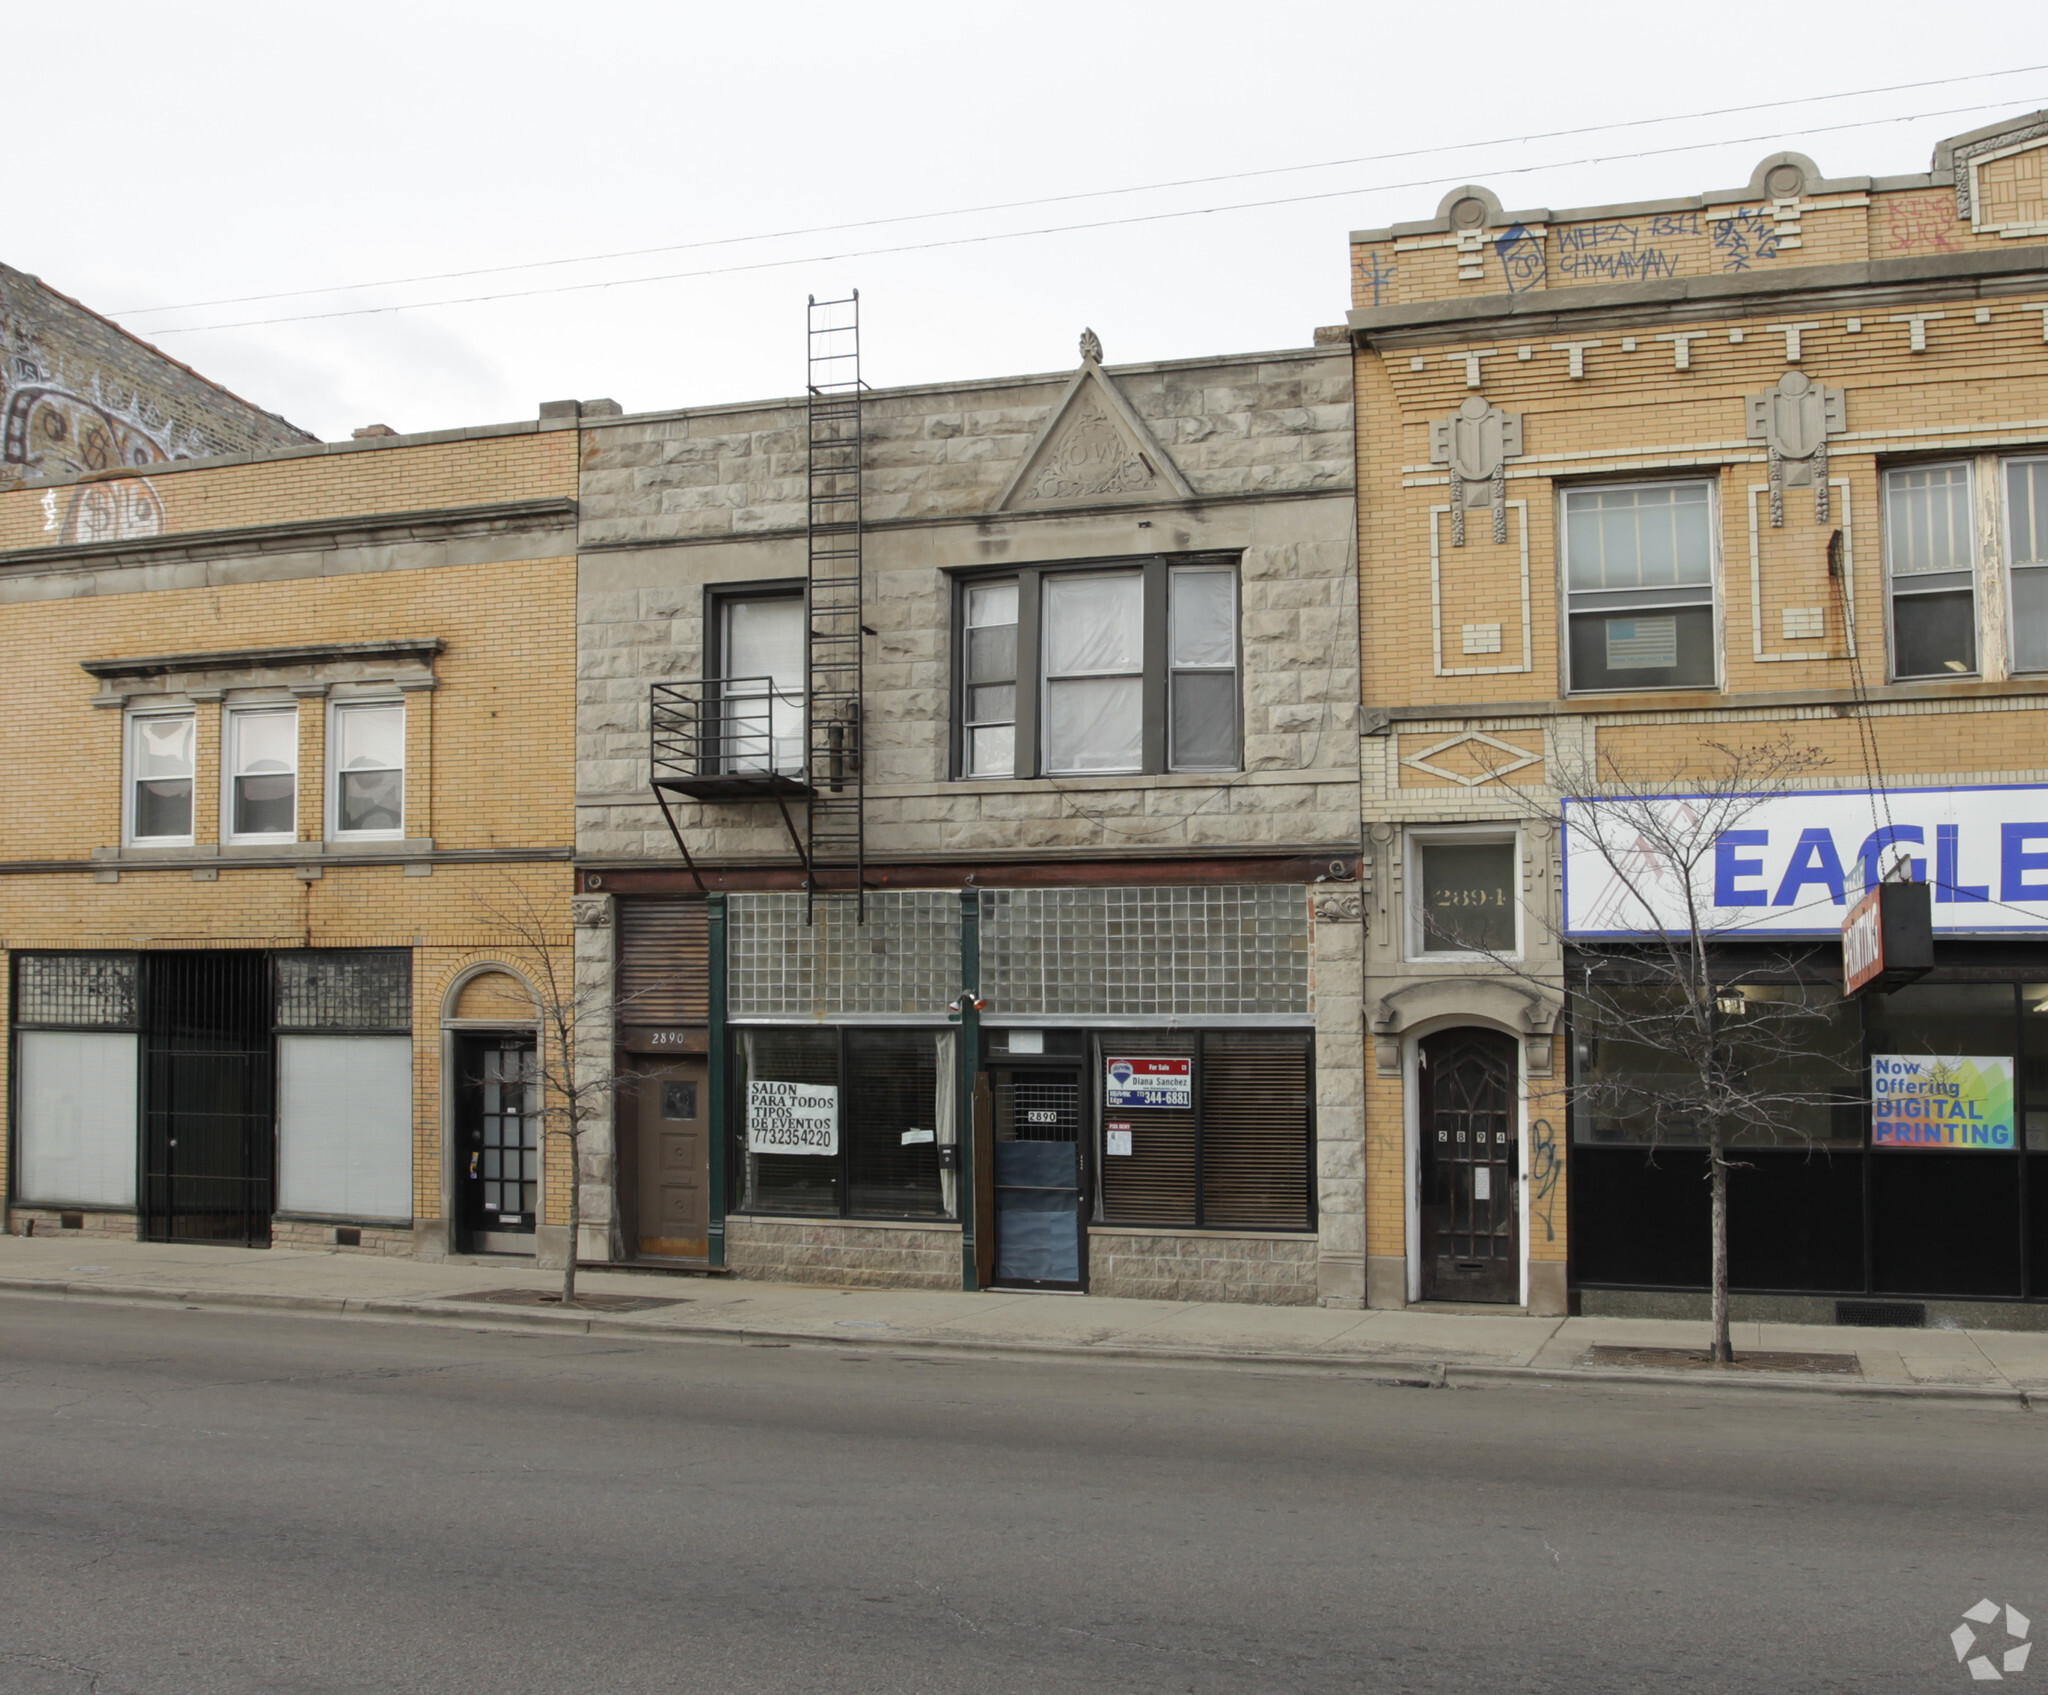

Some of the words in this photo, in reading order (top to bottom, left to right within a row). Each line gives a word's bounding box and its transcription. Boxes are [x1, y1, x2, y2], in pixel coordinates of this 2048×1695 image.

[1557, 224, 1639, 254] WEEZY
[1714, 823, 2048, 906] EAGLE
[1843, 902, 1879, 979] PRINTING
[652, 1032, 684, 1044] 2890
[1876, 1059, 1920, 1074] Now
[752, 1082, 797, 1095] SALON
[1132, 1077, 1153, 1086] Diana
[1156, 1077, 1187, 1086] Sanchez
[1876, 1078, 1960, 1097] Offering
[751, 1095, 786, 1106] PARA
[789, 1096, 834, 1108] TODOS
[1144, 1091, 1188, 1105] 344-6881
[754, 1107, 792, 1118] TIPOS
[1877, 1098, 1983, 1119] DIGITAL
[751, 1118, 768, 1128] DE
[771, 1118, 831, 1129] EVENTOS
[1030, 1112, 1056, 1121] 2890
[1877, 1122, 2009, 1145] PRINTING
